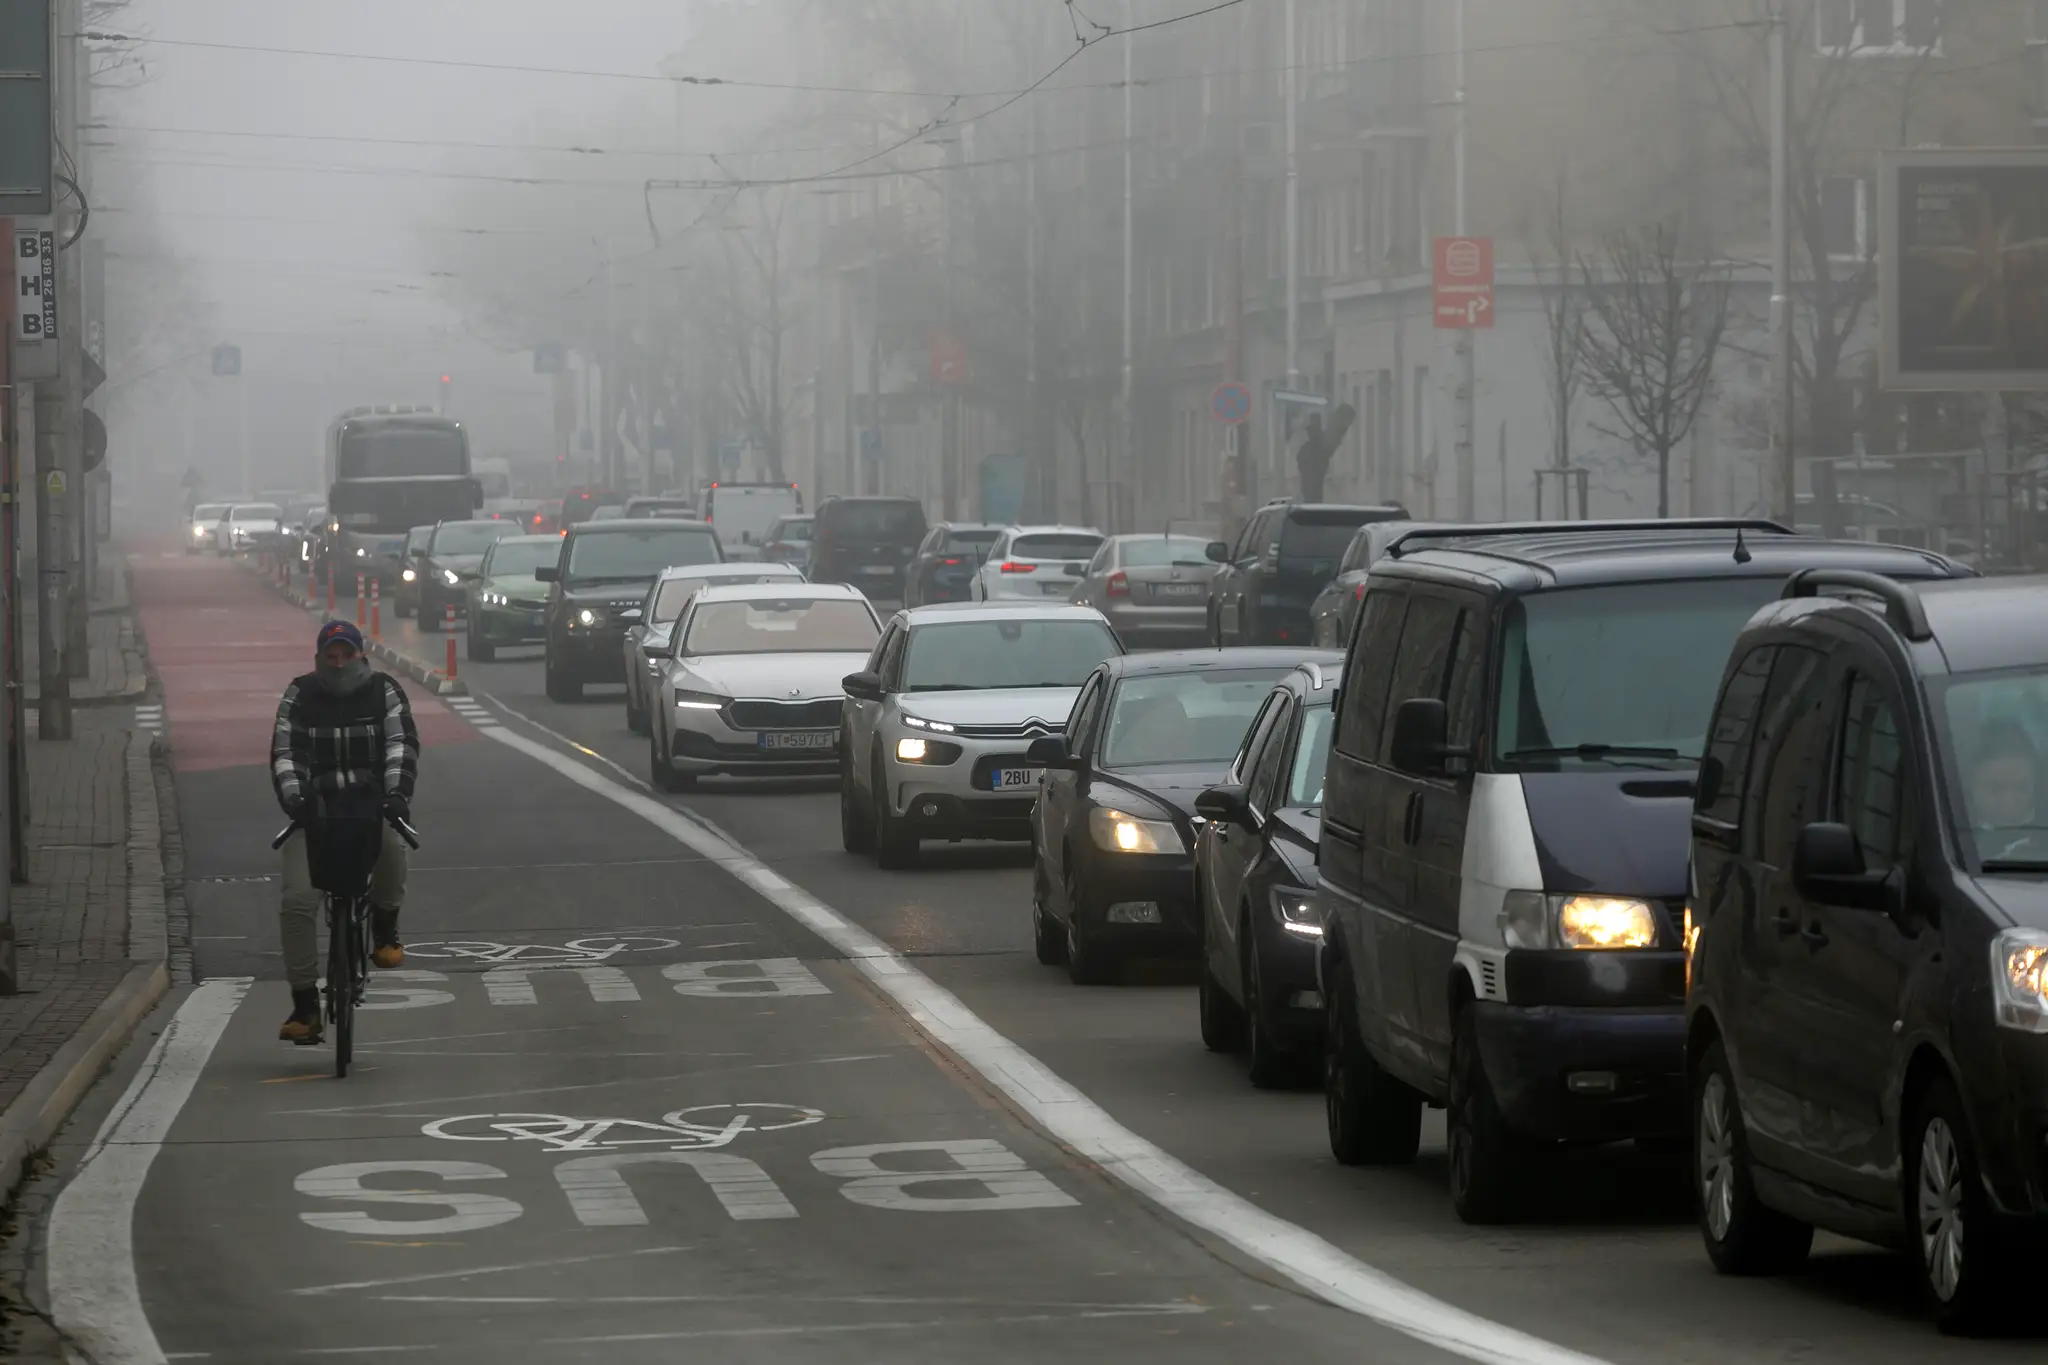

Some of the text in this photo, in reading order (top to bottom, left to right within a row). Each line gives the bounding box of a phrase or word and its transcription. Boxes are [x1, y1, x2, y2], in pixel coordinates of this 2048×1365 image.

[42, 237, 54, 333] 0911 26 86 33
[1004, 770, 1031, 785] 2BU
[293, 1138, 1082, 1236] BUS
